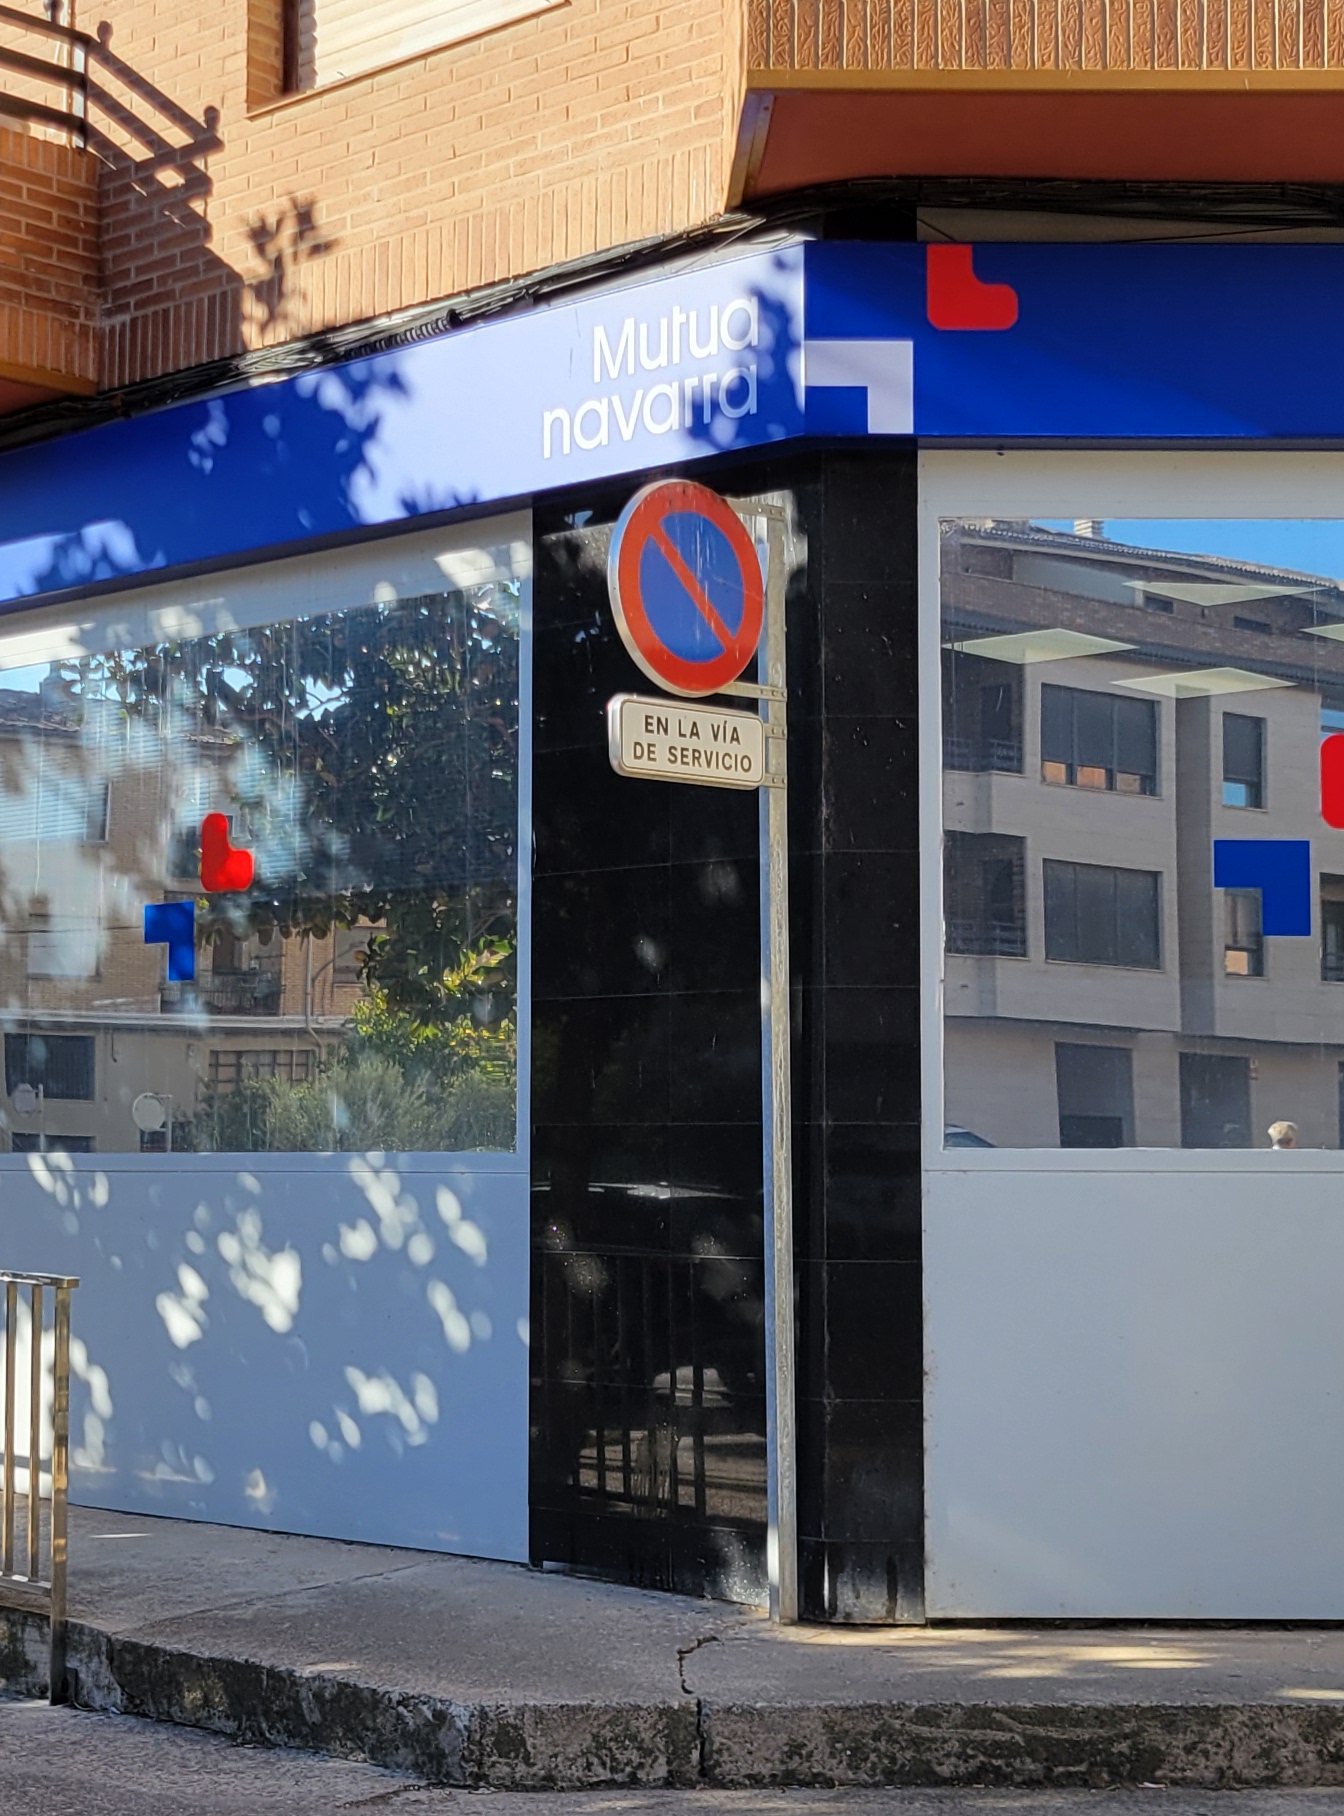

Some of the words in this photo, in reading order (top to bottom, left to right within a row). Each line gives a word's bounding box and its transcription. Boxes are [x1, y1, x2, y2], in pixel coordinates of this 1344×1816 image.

[592, 295, 759, 384] Mutua
[542, 364, 758, 459] navarra
[632, 741, 657, 762] DE
[667, 745, 752, 773] SERVICIO
[643, 714, 669, 737] EN
[678, 718, 701, 741] LA
[710, 720, 741, 746] VÍA
